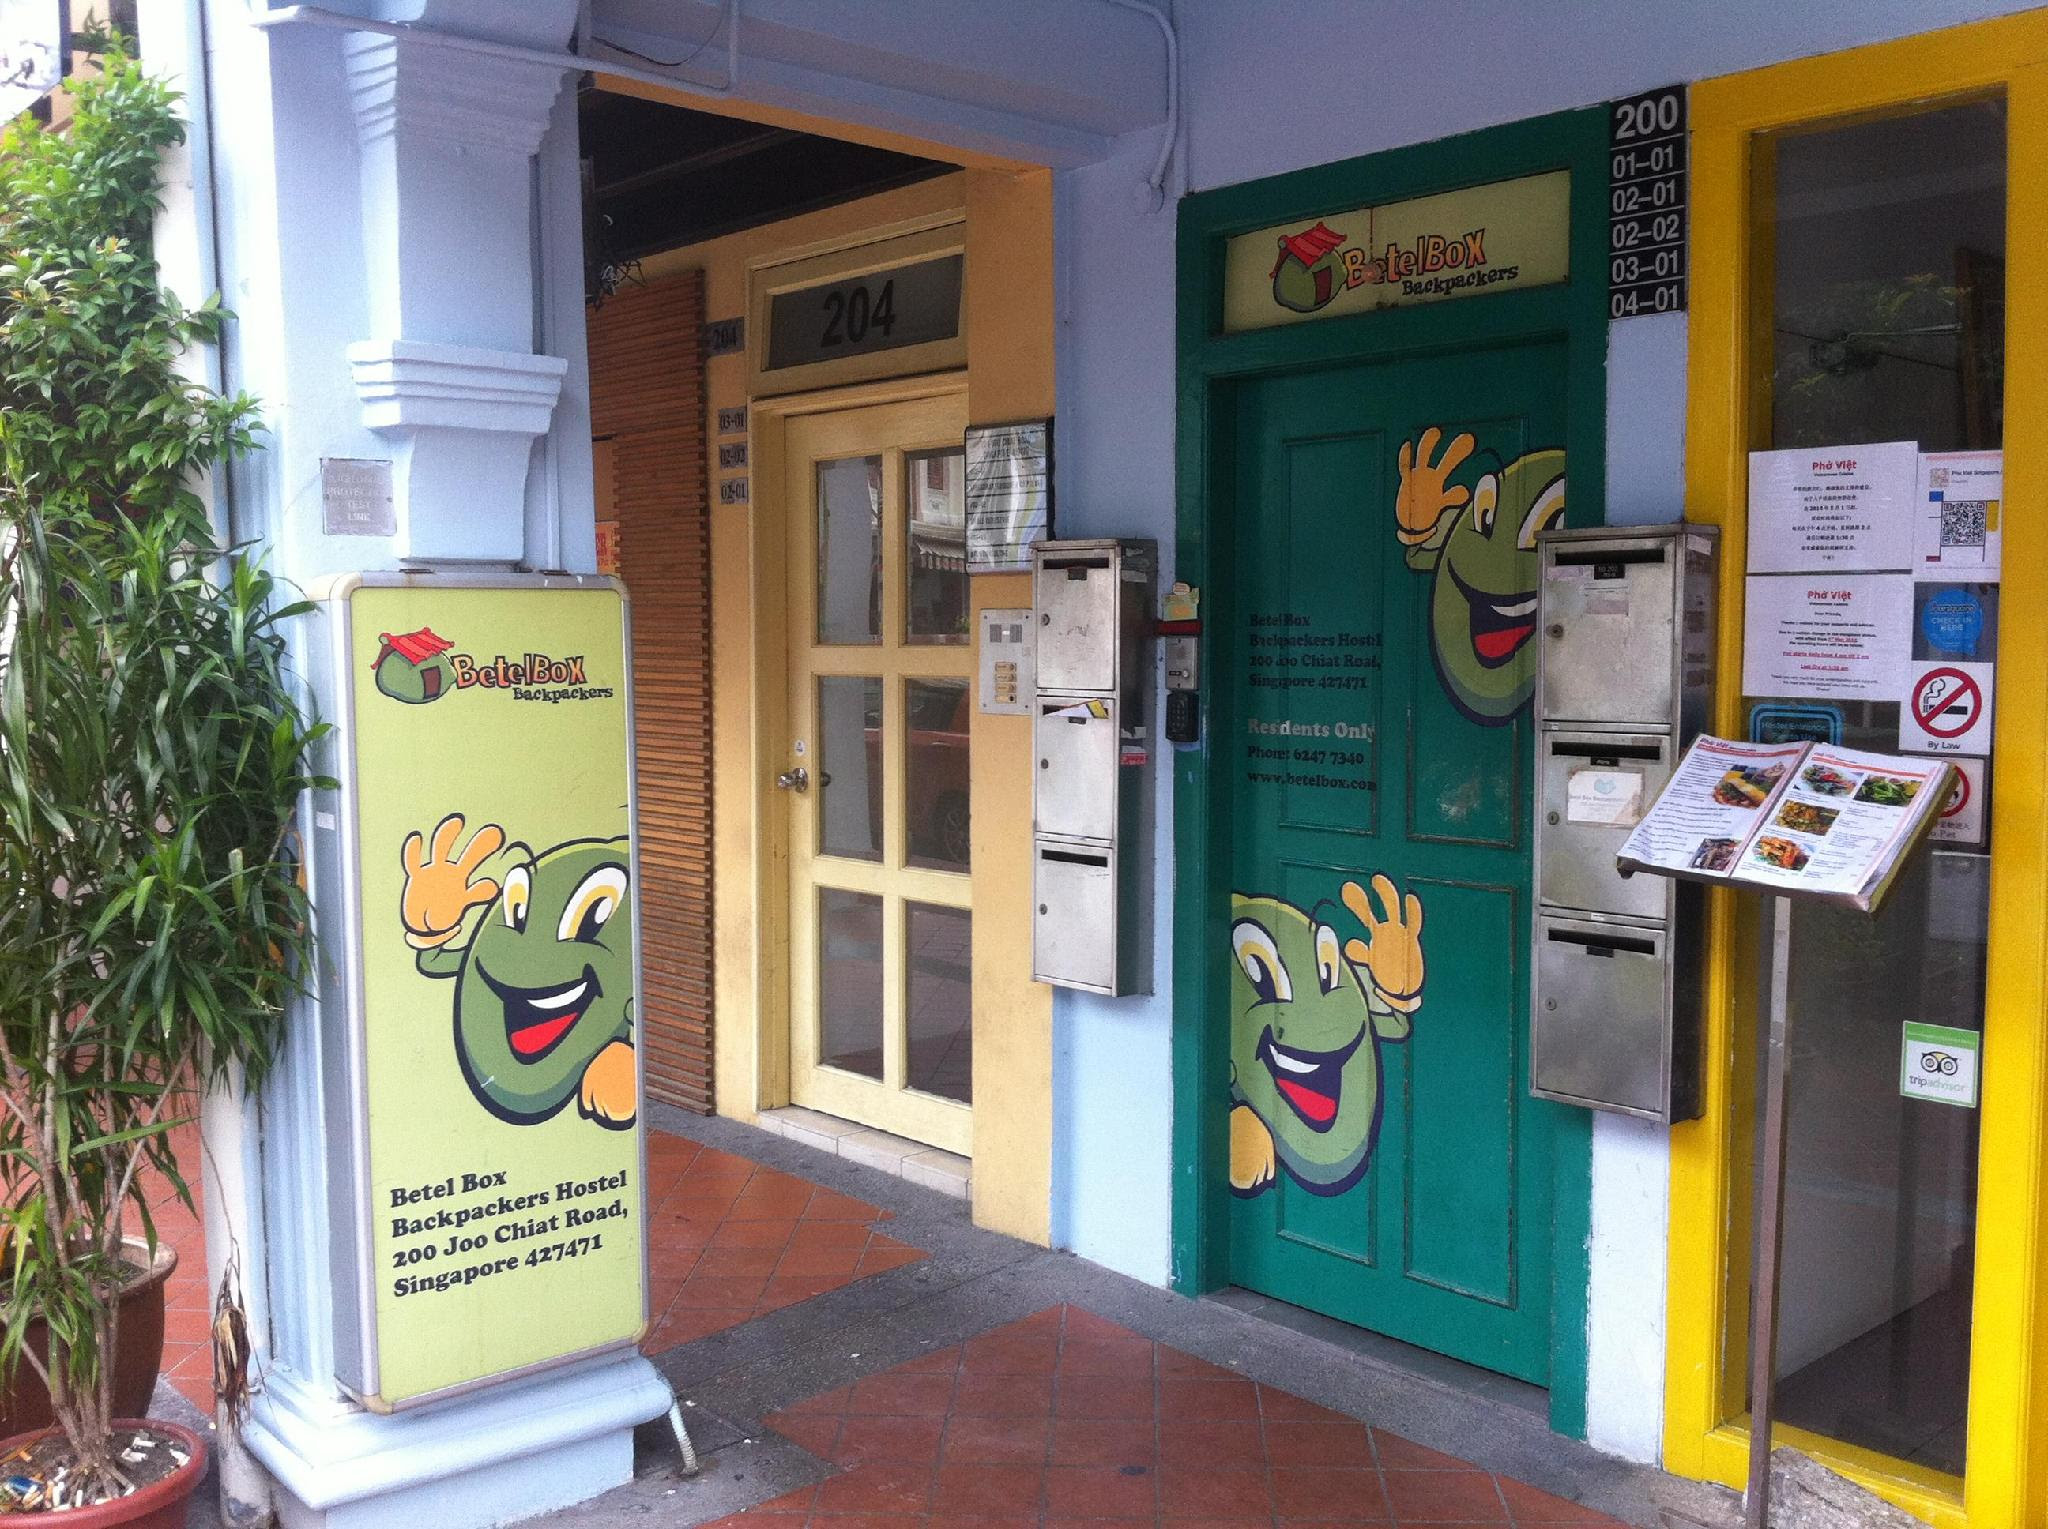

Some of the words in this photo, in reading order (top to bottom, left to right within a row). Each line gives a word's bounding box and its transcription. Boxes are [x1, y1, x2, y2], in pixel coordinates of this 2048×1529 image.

[1615, 95, 1678, 139] 200
[1612, 144, 1674, 178] 01-01
[1612, 179, 1676, 213] 02-01
[1612, 214, 1680, 248] 02-02
[1402, 266, 1519, 295] Backpackers
[1612, 249, 1678, 283] 03-01
[821, 279, 896, 347] 204
[1611, 284, 1678, 318] 04-01
[712, 325, 738, 350] 204
[720, 413, 745, 431] 03-01
[721, 482, 746, 500] 02-01
[1250, 613, 1282, 627] Betel
[1283, 613, 1311, 627] Box
[1302, 653, 1340, 668] Chiat
[513, 687, 613, 704] Backpackers
[1319, 676, 1368, 690] 427471
[1248, 718, 1330, 737] Residents
[1334, 721, 1376, 743] Only
[1293, 747, 1326, 765] 6247
[1330, 751, 1365, 766] 7340
[1927, 741, 1940, 750] By
[1941, 741, 1961, 750] Law
[1909, 1075, 1966, 1092] tripadvisor
[390, 1178, 455, 1208] Betel
[461, 1171, 507, 1193] Box
[391, 1191, 550, 1238] Backpackers
[555, 1170, 627, 1201] Hostel
[393, 1245, 437, 1268] 200
[443, 1235, 489, 1256] Joo
[494, 1215, 560, 1243] Chiat
[565, 1199, 628, 1229] Road,
[394, 1256, 519, 1297] Singapore
[525, 1234, 604, 1267] 427471
